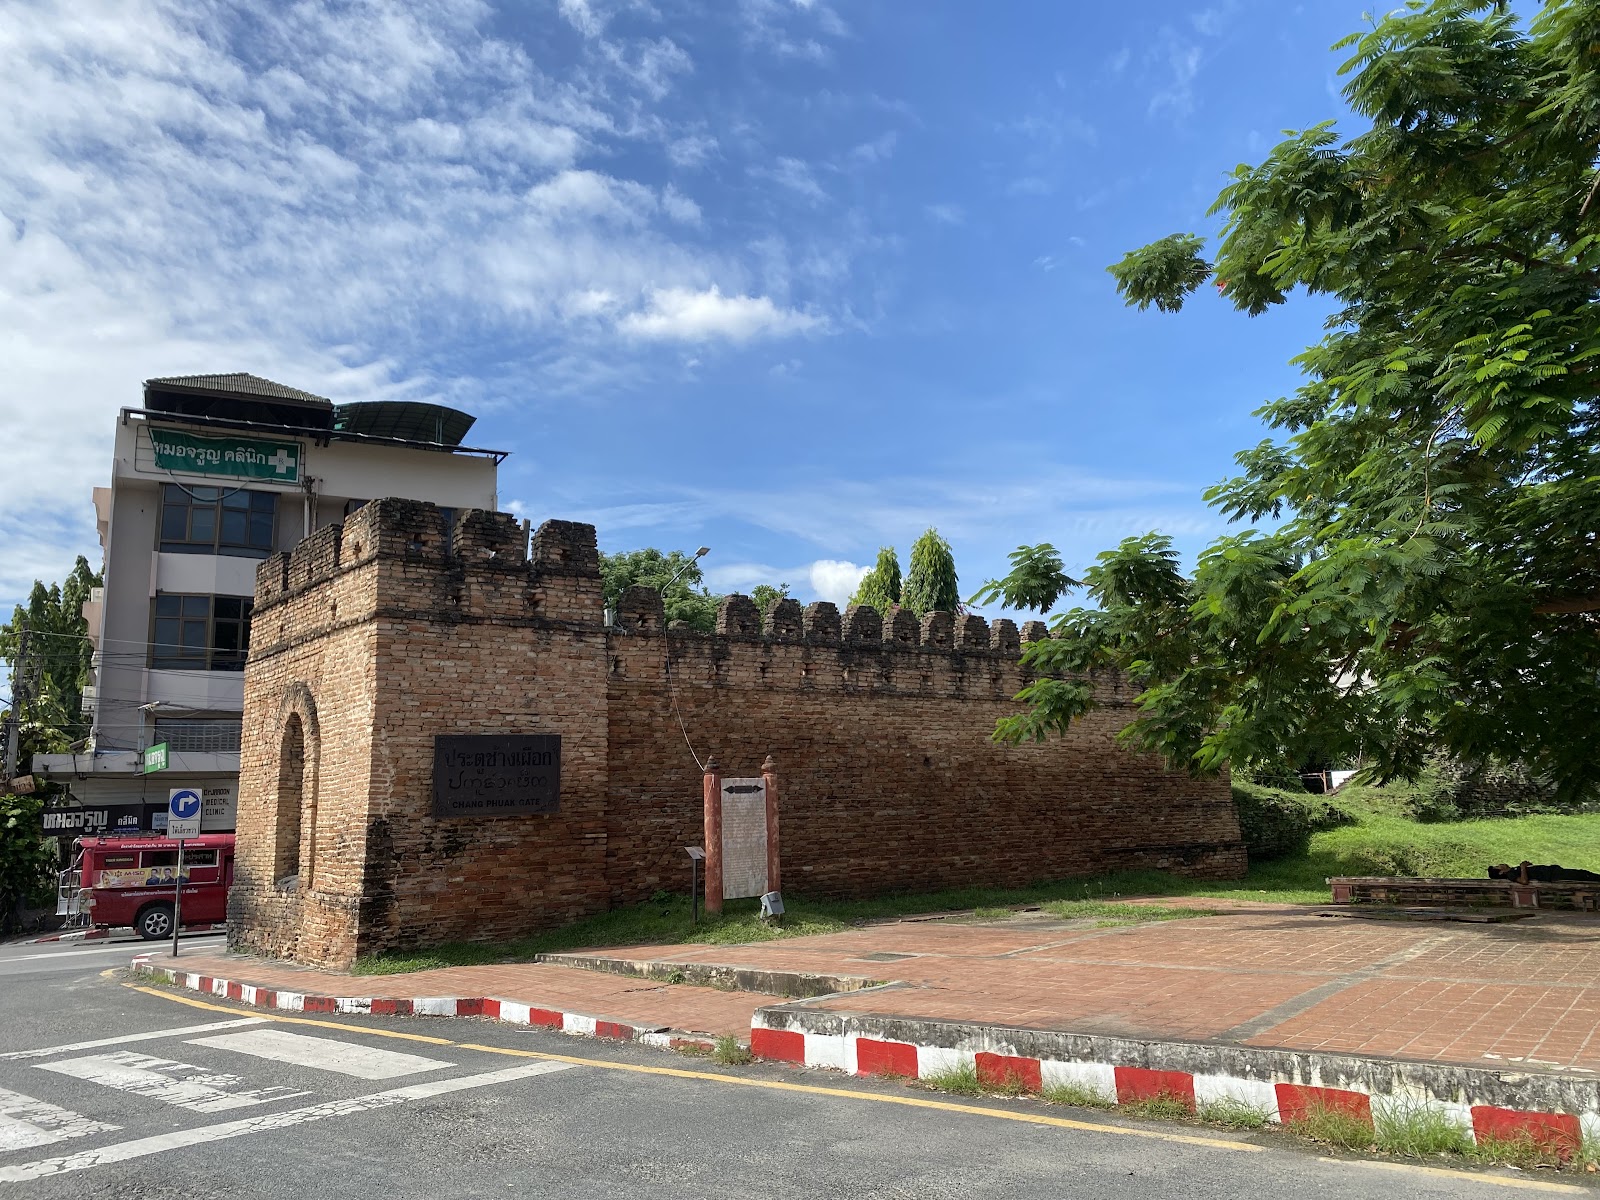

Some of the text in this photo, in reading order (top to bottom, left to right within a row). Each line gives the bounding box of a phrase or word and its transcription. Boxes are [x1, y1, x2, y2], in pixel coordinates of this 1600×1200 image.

[224, 446, 266, 465] คลินิก
[452, 798, 541, 808] CHANG PHUAK GATE
[205, 808, 225, 816] CLINIC
